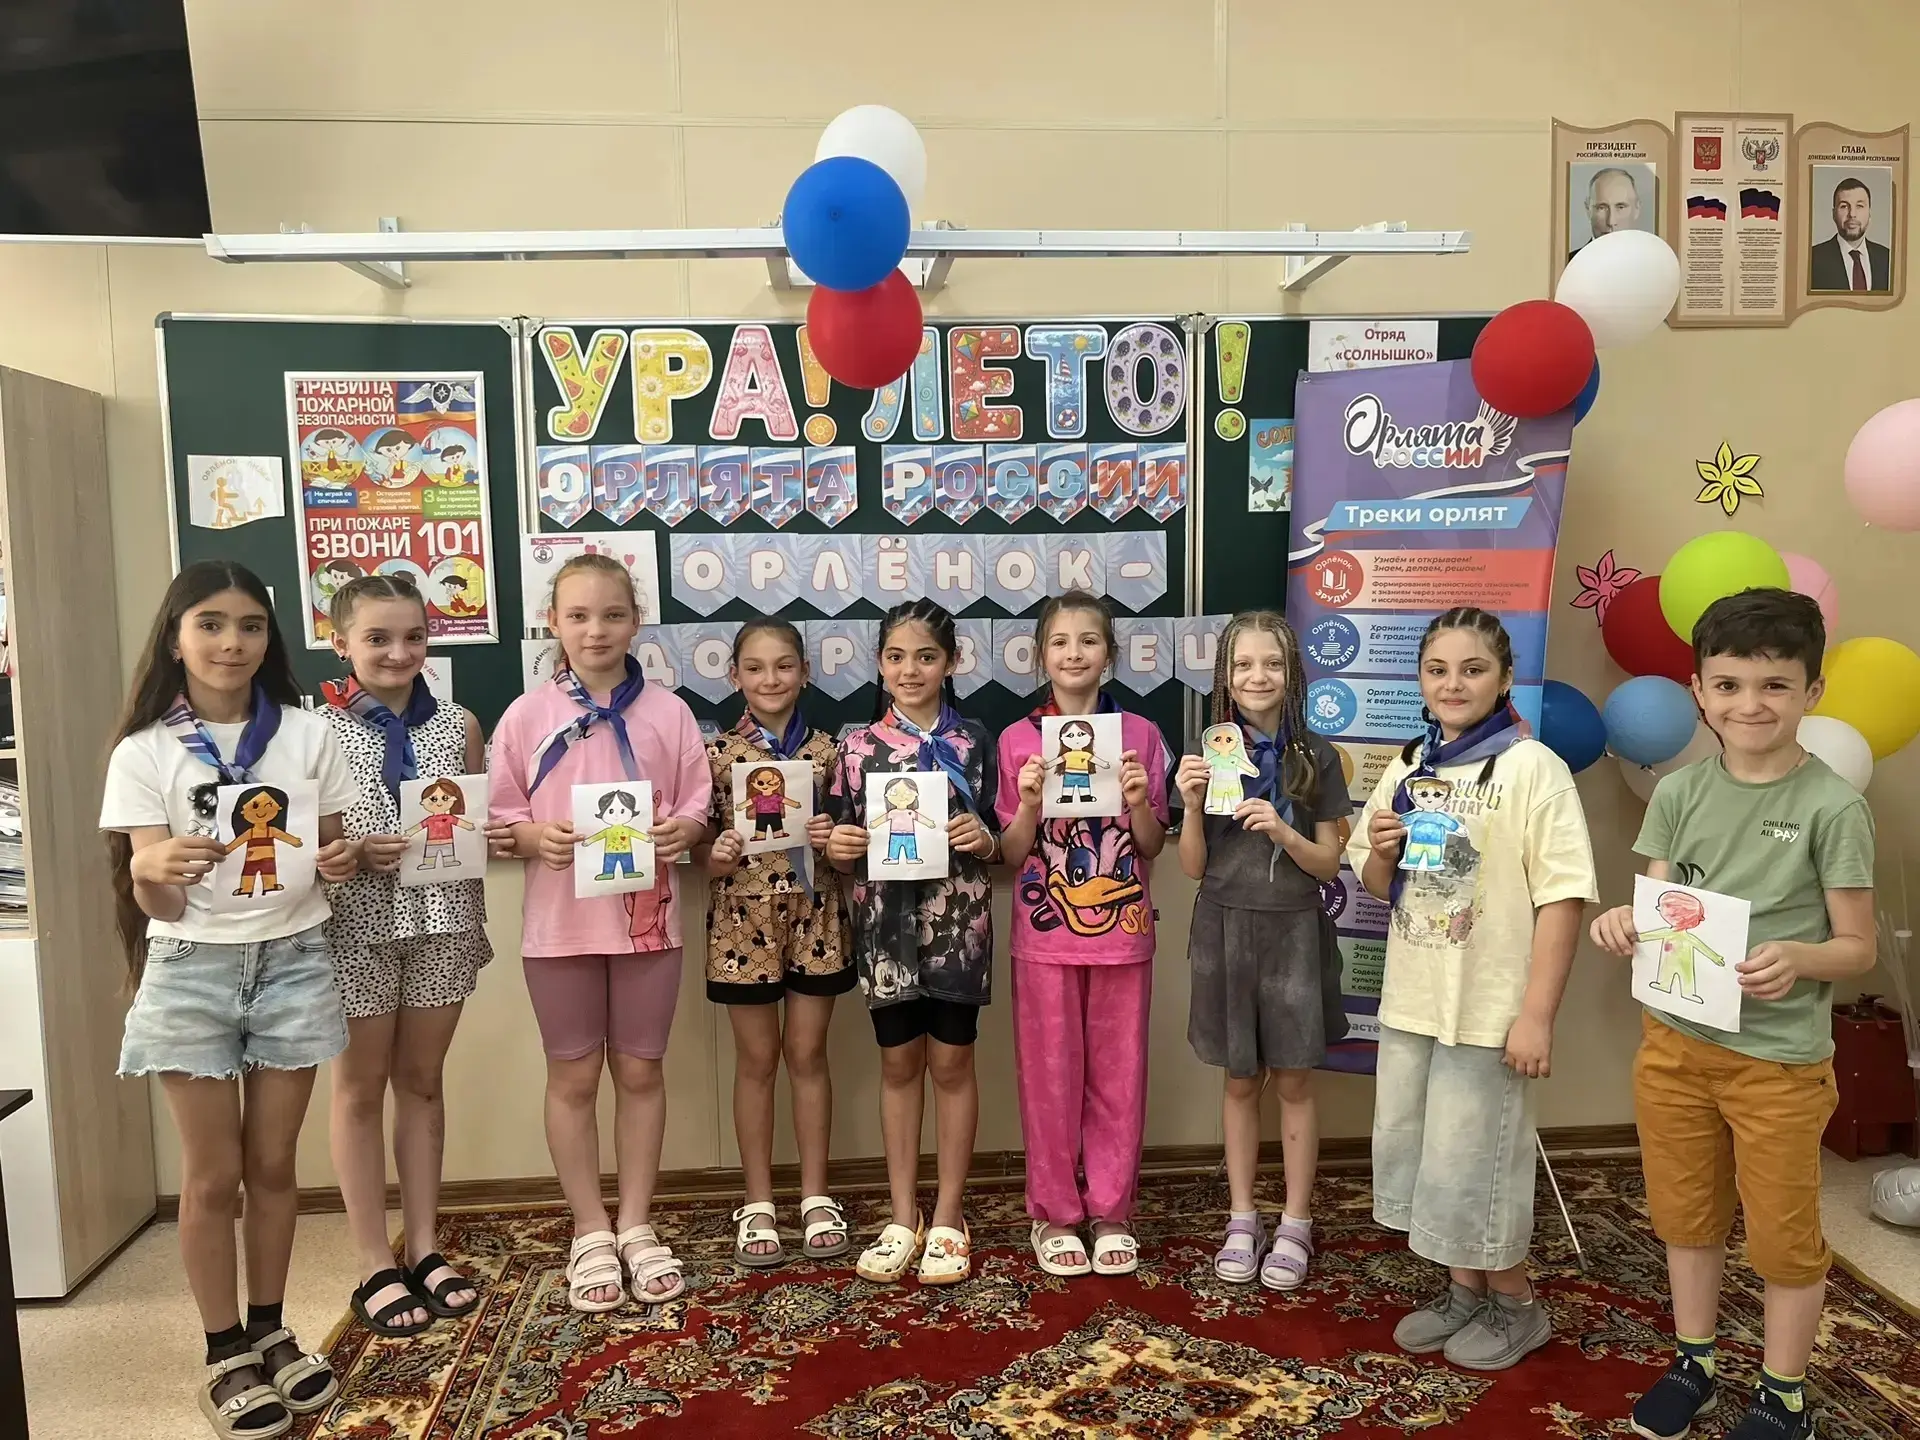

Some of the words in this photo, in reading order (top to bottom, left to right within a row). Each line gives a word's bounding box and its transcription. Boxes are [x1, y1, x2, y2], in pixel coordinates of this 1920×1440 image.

[1586, 142, 1637, 151] ПРЕЗИДЕНТ
[1841, 145, 1867, 154] ГЛАВА
[1364, 328, 1406, 342] Отряд
[1335, 348, 1434, 361] «СОЛНЫШКО»
[297, 413, 396, 425] БЕЗОПАСНОСТИ
[1345, 394, 1485, 460] Орлята
[1378, 446, 1482, 466] РОССИИ
[548, 461, 852, 501] ОРЛЯТА
[893, 459, 1180, 501] РОССИИ
[304, 492, 313, 504] 1
[359, 490, 370, 504] 2
[424, 489, 435, 503] 3
[1344, 505, 1420, 528] Треки
[1429, 506, 1508, 528] орлят
[309, 518, 342, 531] ПРИ
[346, 517, 411, 531] ПОЖАРЕ
[310, 532, 412, 558] ЗВОНИ
[417, 521, 479, 556] 101
[682, 536, 1153, 592] ОРЛЁНОК-
[1373, 556, 1407, 564] Узнаём
[1417, 556, 1472, 565] открываем!
[1373, 564, 1404, 572] Знаем,
[1406, 565, 1442, 573] делаем,
[1445, 565, 1486, 573] решаем!
[1315, 589, 1352, 603] ЭРУДИТ
[428, 618, 439, 632] 3
[1370, 624, 1406, 633] Храним
[1370, 632, 1381, 640] Её
[1307, 644, 1355, 667] ХРАНИТЕЛЬ
[423, 664, 440, 681] УДИТ
[1367, 688, 1395, 697] Орлят
[1308, 715, 1345, 730] МАСТЕР
[1366, 713, 1411, 721] Содействие
[1774, 828, 1799, 843] DAY
[1020, 864, 1064, 932] YOU
[1356, 902, 1392, 911] Формиро
[1353, 952, 1369, 960] Это
[1352, 968, 1384, 976] Содейст
[1351, 1023, 1380, 1034] астё
[1663, 1372, 1700, 1397] ASHION
